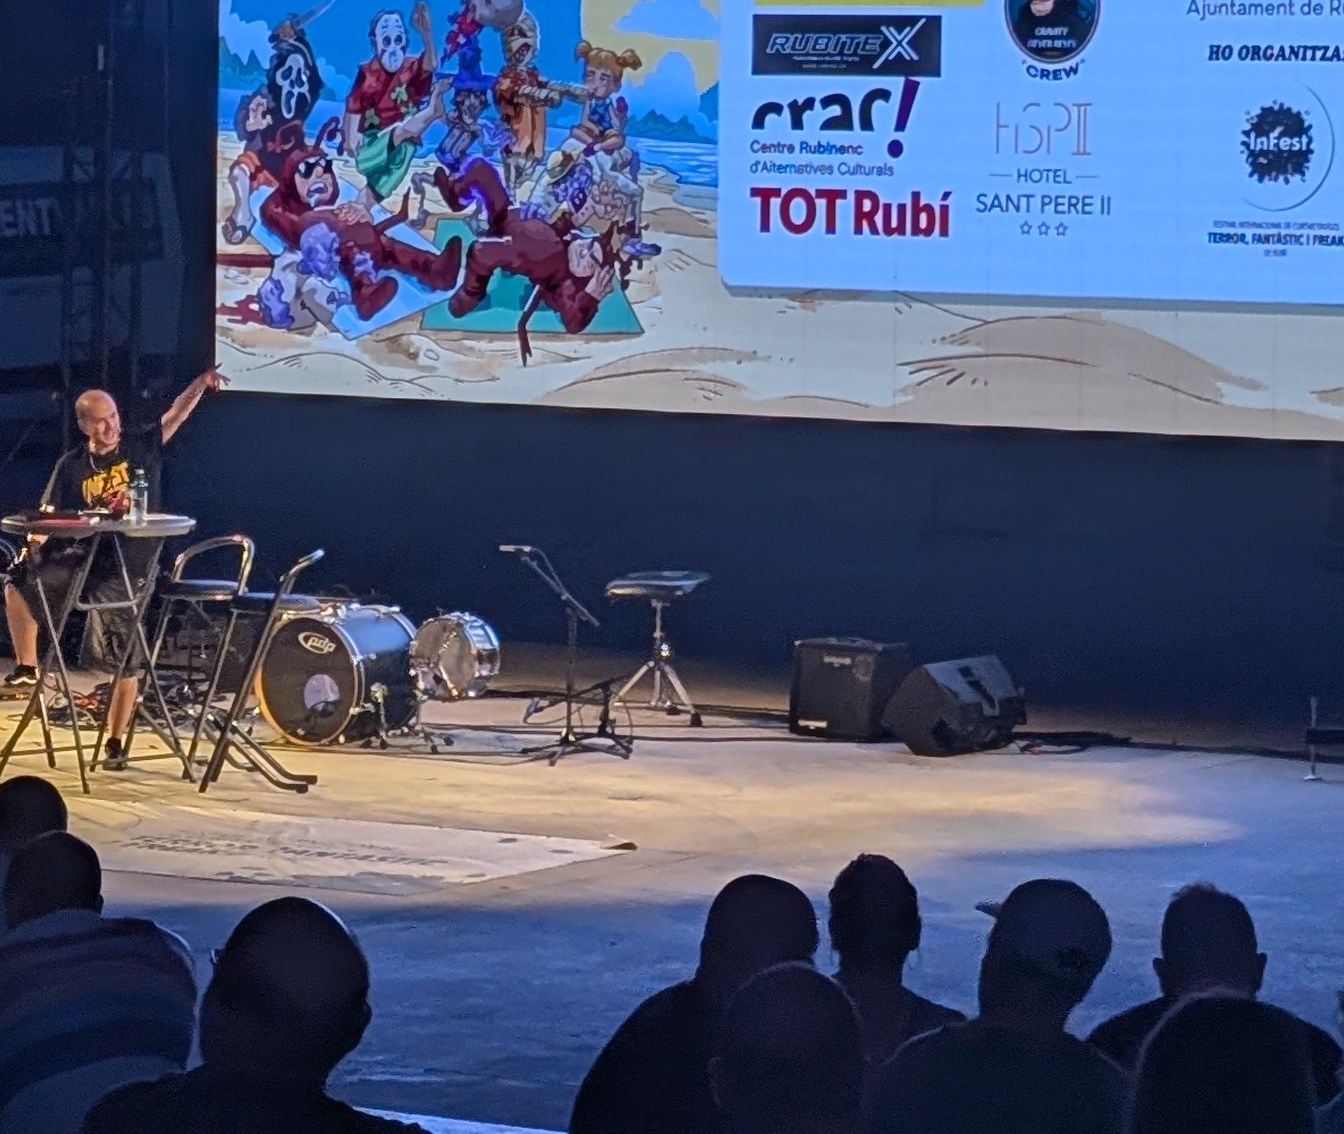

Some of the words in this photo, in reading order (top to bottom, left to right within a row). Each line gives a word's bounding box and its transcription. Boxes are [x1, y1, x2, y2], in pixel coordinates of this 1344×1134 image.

[1207, 45, 1233, 61] HO
[1025, 63, 1081, 81] CREW
[750, 139, 795, 155] Centre
[1017, 168, 1073, 184] HOTEL
[976, 192, 1035, 214] SANT
[1040, 194, 1094, 215] PERE
